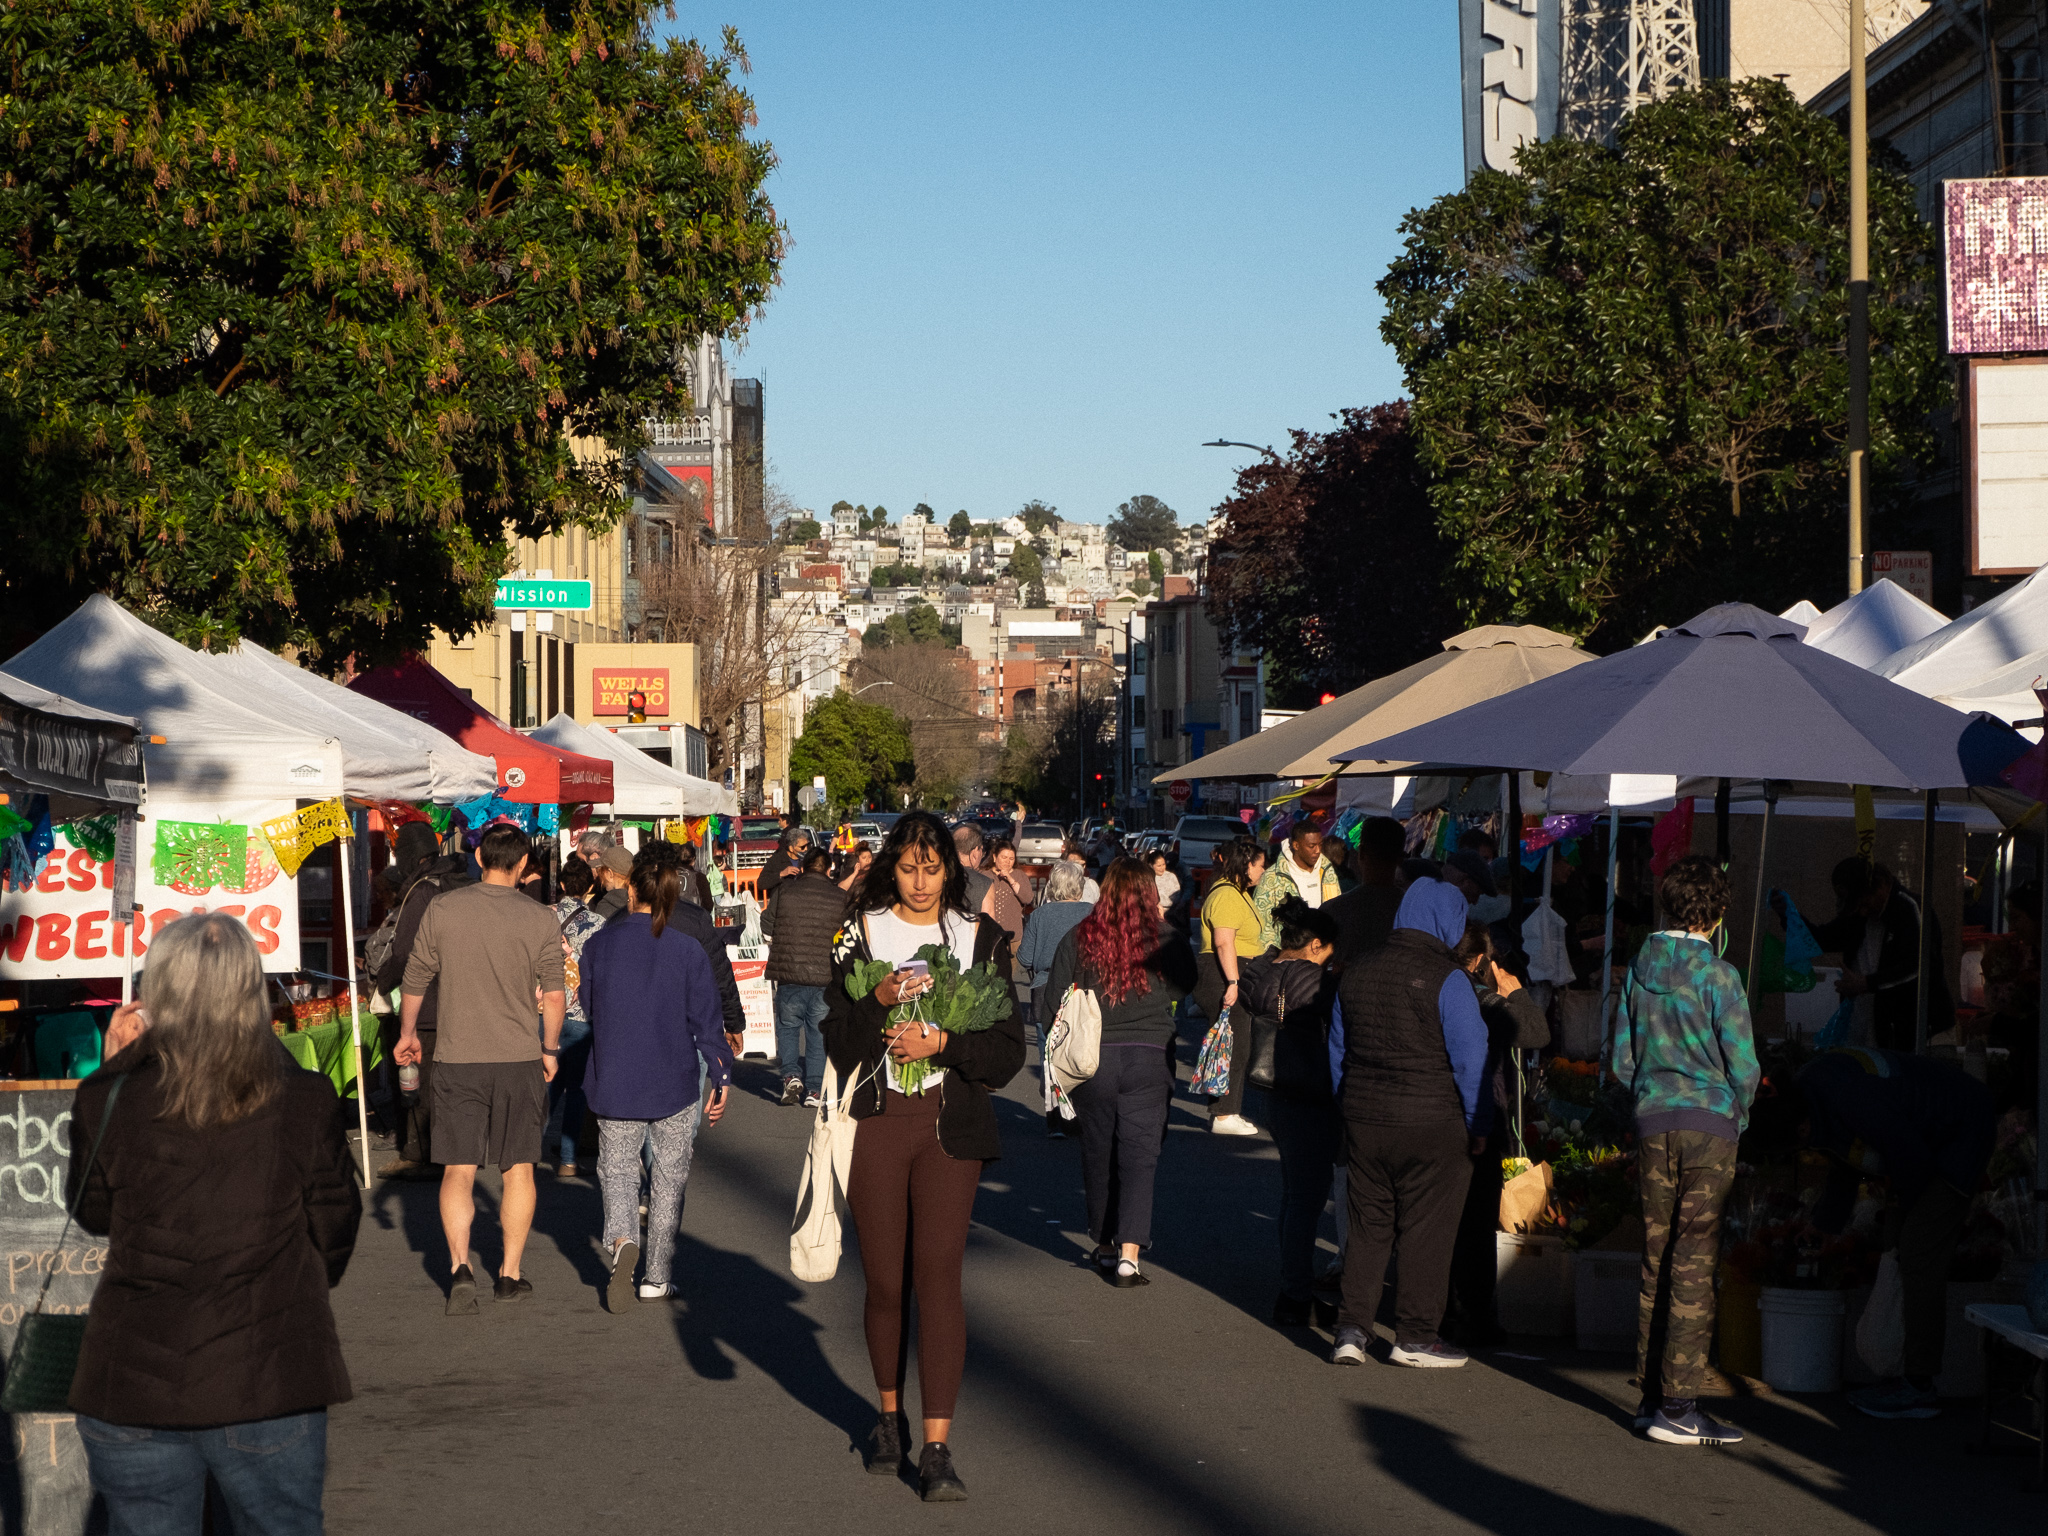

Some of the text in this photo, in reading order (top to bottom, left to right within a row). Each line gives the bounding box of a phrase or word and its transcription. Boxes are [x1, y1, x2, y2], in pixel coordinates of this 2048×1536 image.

[1874, 554, 1929, 570] NO PARKING
[495, 586, 568, 602] Mission
[598, 677, 665, 691] WELLS
[1170, 785, 1190, 796] STOP
